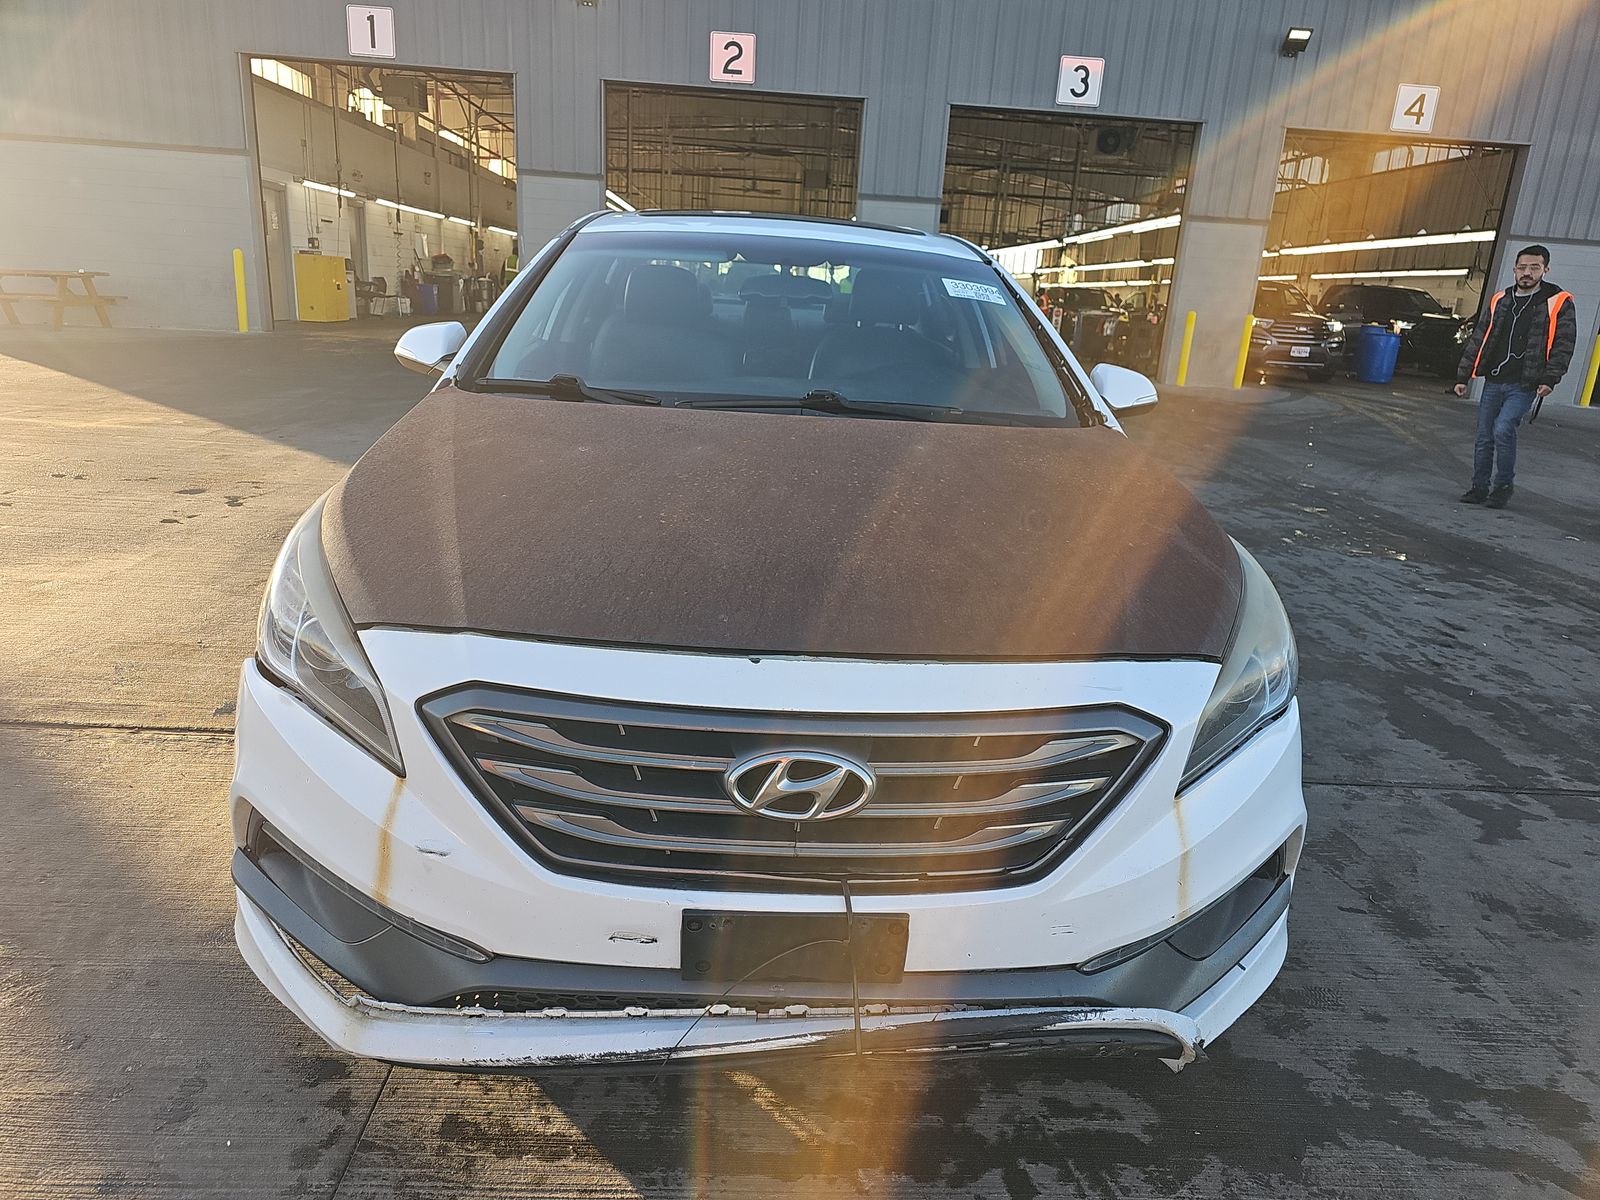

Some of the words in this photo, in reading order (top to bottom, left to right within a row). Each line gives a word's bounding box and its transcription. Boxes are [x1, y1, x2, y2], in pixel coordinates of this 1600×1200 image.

[366, 14, 377, 49] 1
[722, 40, 744, 76] 2
[1069, 64, 1090, 98] 3
[1403, 93, 1427, 126] 4
